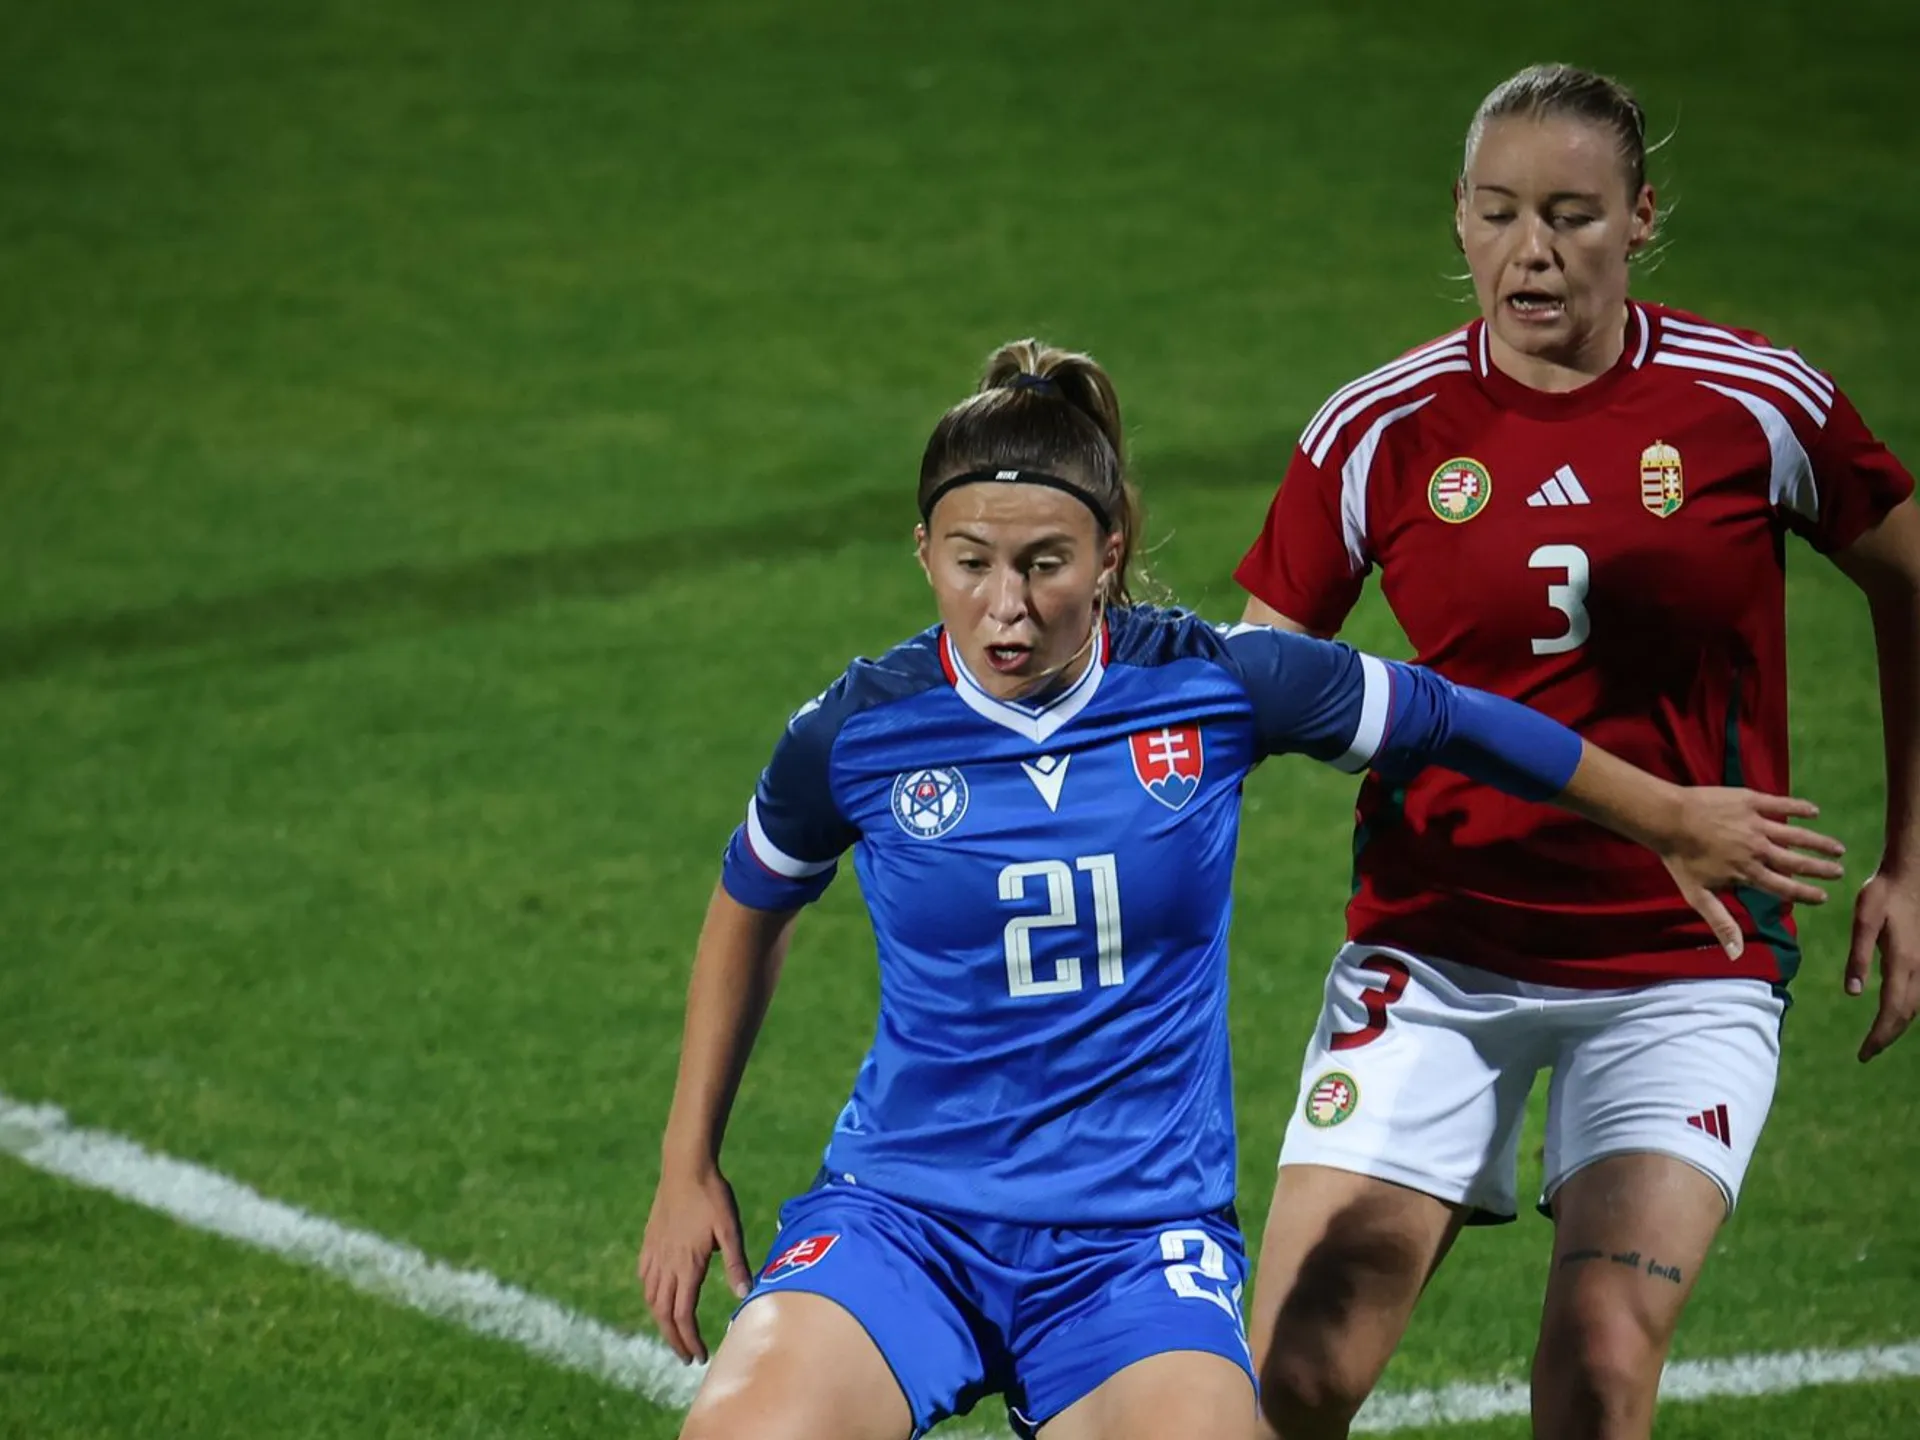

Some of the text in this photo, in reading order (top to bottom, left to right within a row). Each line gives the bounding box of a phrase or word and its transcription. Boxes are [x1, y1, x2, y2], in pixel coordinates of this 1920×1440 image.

[1527, 544, 1591, 655] 3
[998, 853, 1124, 998] 21
[1329, 954, 1410, 1051] 3
[1160, 1229, 1242, 1320] 2
